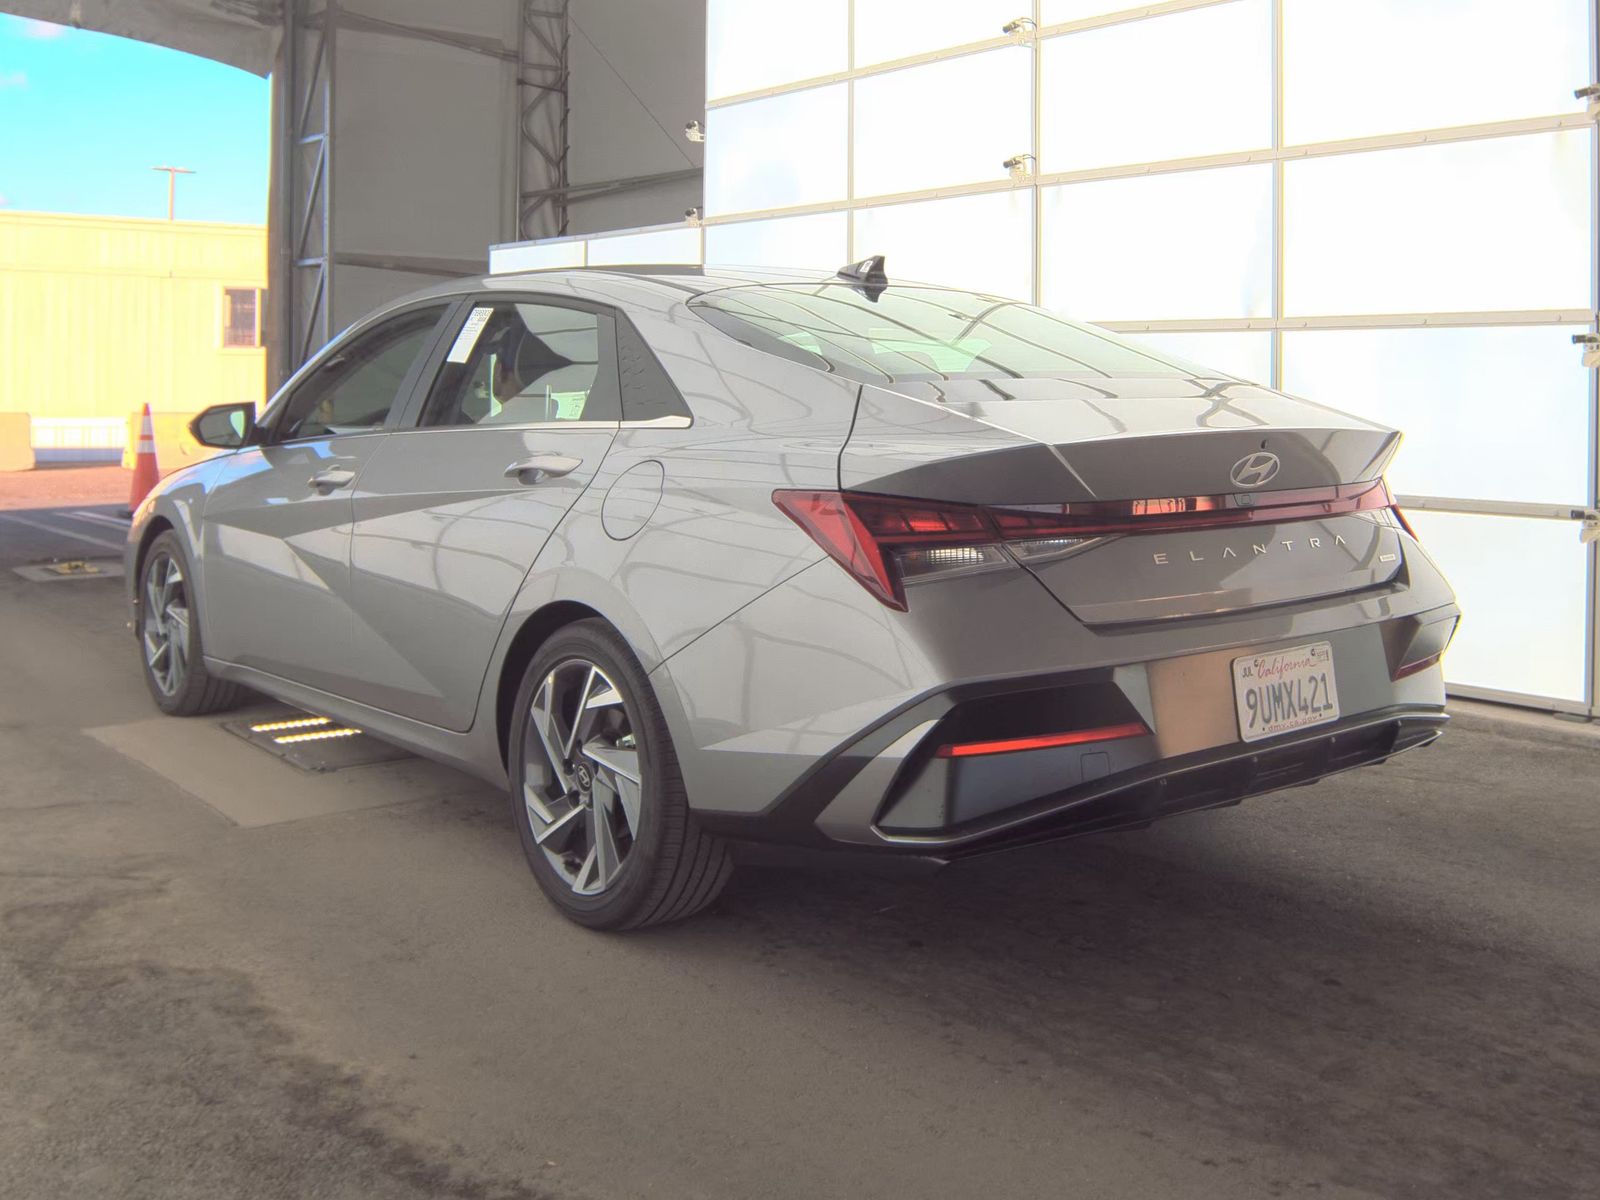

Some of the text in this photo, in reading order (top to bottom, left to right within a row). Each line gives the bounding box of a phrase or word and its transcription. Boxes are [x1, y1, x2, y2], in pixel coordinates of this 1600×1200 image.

[1153, 535, 1346, 565] ELANTRA
[1257, 656, 1316, 679] California
[1246, 672, 1333, 729] 9UMX421
